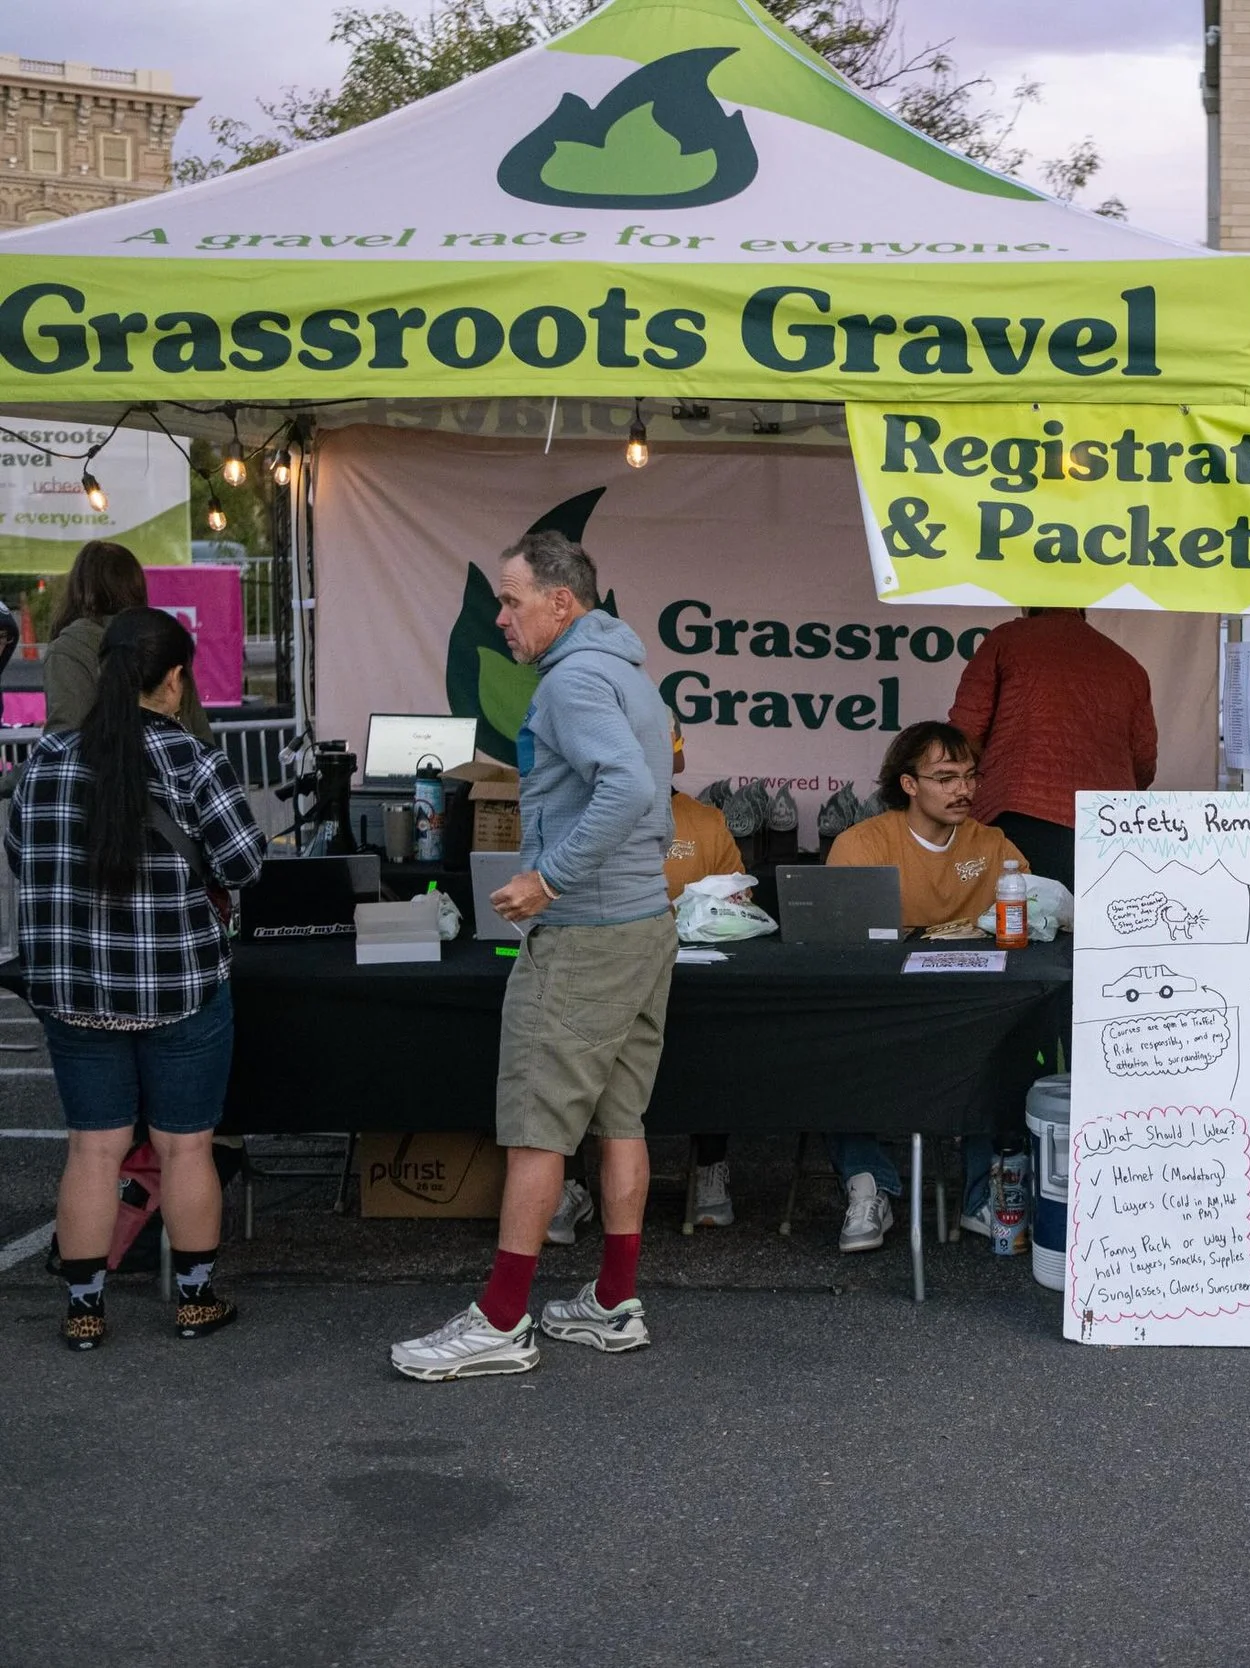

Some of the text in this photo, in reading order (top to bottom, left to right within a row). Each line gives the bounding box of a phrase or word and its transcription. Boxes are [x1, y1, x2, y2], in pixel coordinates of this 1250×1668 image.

[119, 225, 1069, 256] A gravel race for everyone.
[2, 283, 1162, 376] Grassroots Gravel
[0, 428, 109, 444] assroots
[0, 448, 53, 467] avel
[15, 512, 115, 527] everyone.
[881, 495, 946, 560] &
[658, 600, 993, 662] Grassroo
[658, 670, 901, 731] Gravel
[1098, 805, 1188, 841] Safety
[255, 923, 357, 937] I'm doing my bes
[1110, 1027, 1140, 1039] Courses
[1163, 1022, 1177, 1031] open
[1180, 1018, 1187, 1028] to
[1113, 1043, 1133, 1056] Ride
[1194, 1033, 1208, 1042] and
[1212, 1033, 1224, 1043] pay
[1116, 1058, 1149, 1070] attention
[1154, 1055, 1163, 1067] to
[1084, 1120, 1235, 1151] What Should I Wear?
[370, 1160, 446, 1190] purist
[1112, 1159, 1226, 1187] Helmet (Mandatory)
[1113, 1196, 1154, 1215] Layers
[1195, 1197, 1203, 1206] in
[1183, 1207, 1220, 1220] in PM)
[1100, 1226, 1243, 1259] Fanny Pack or way to
[1095, 1263, 1121, 1280] hold
